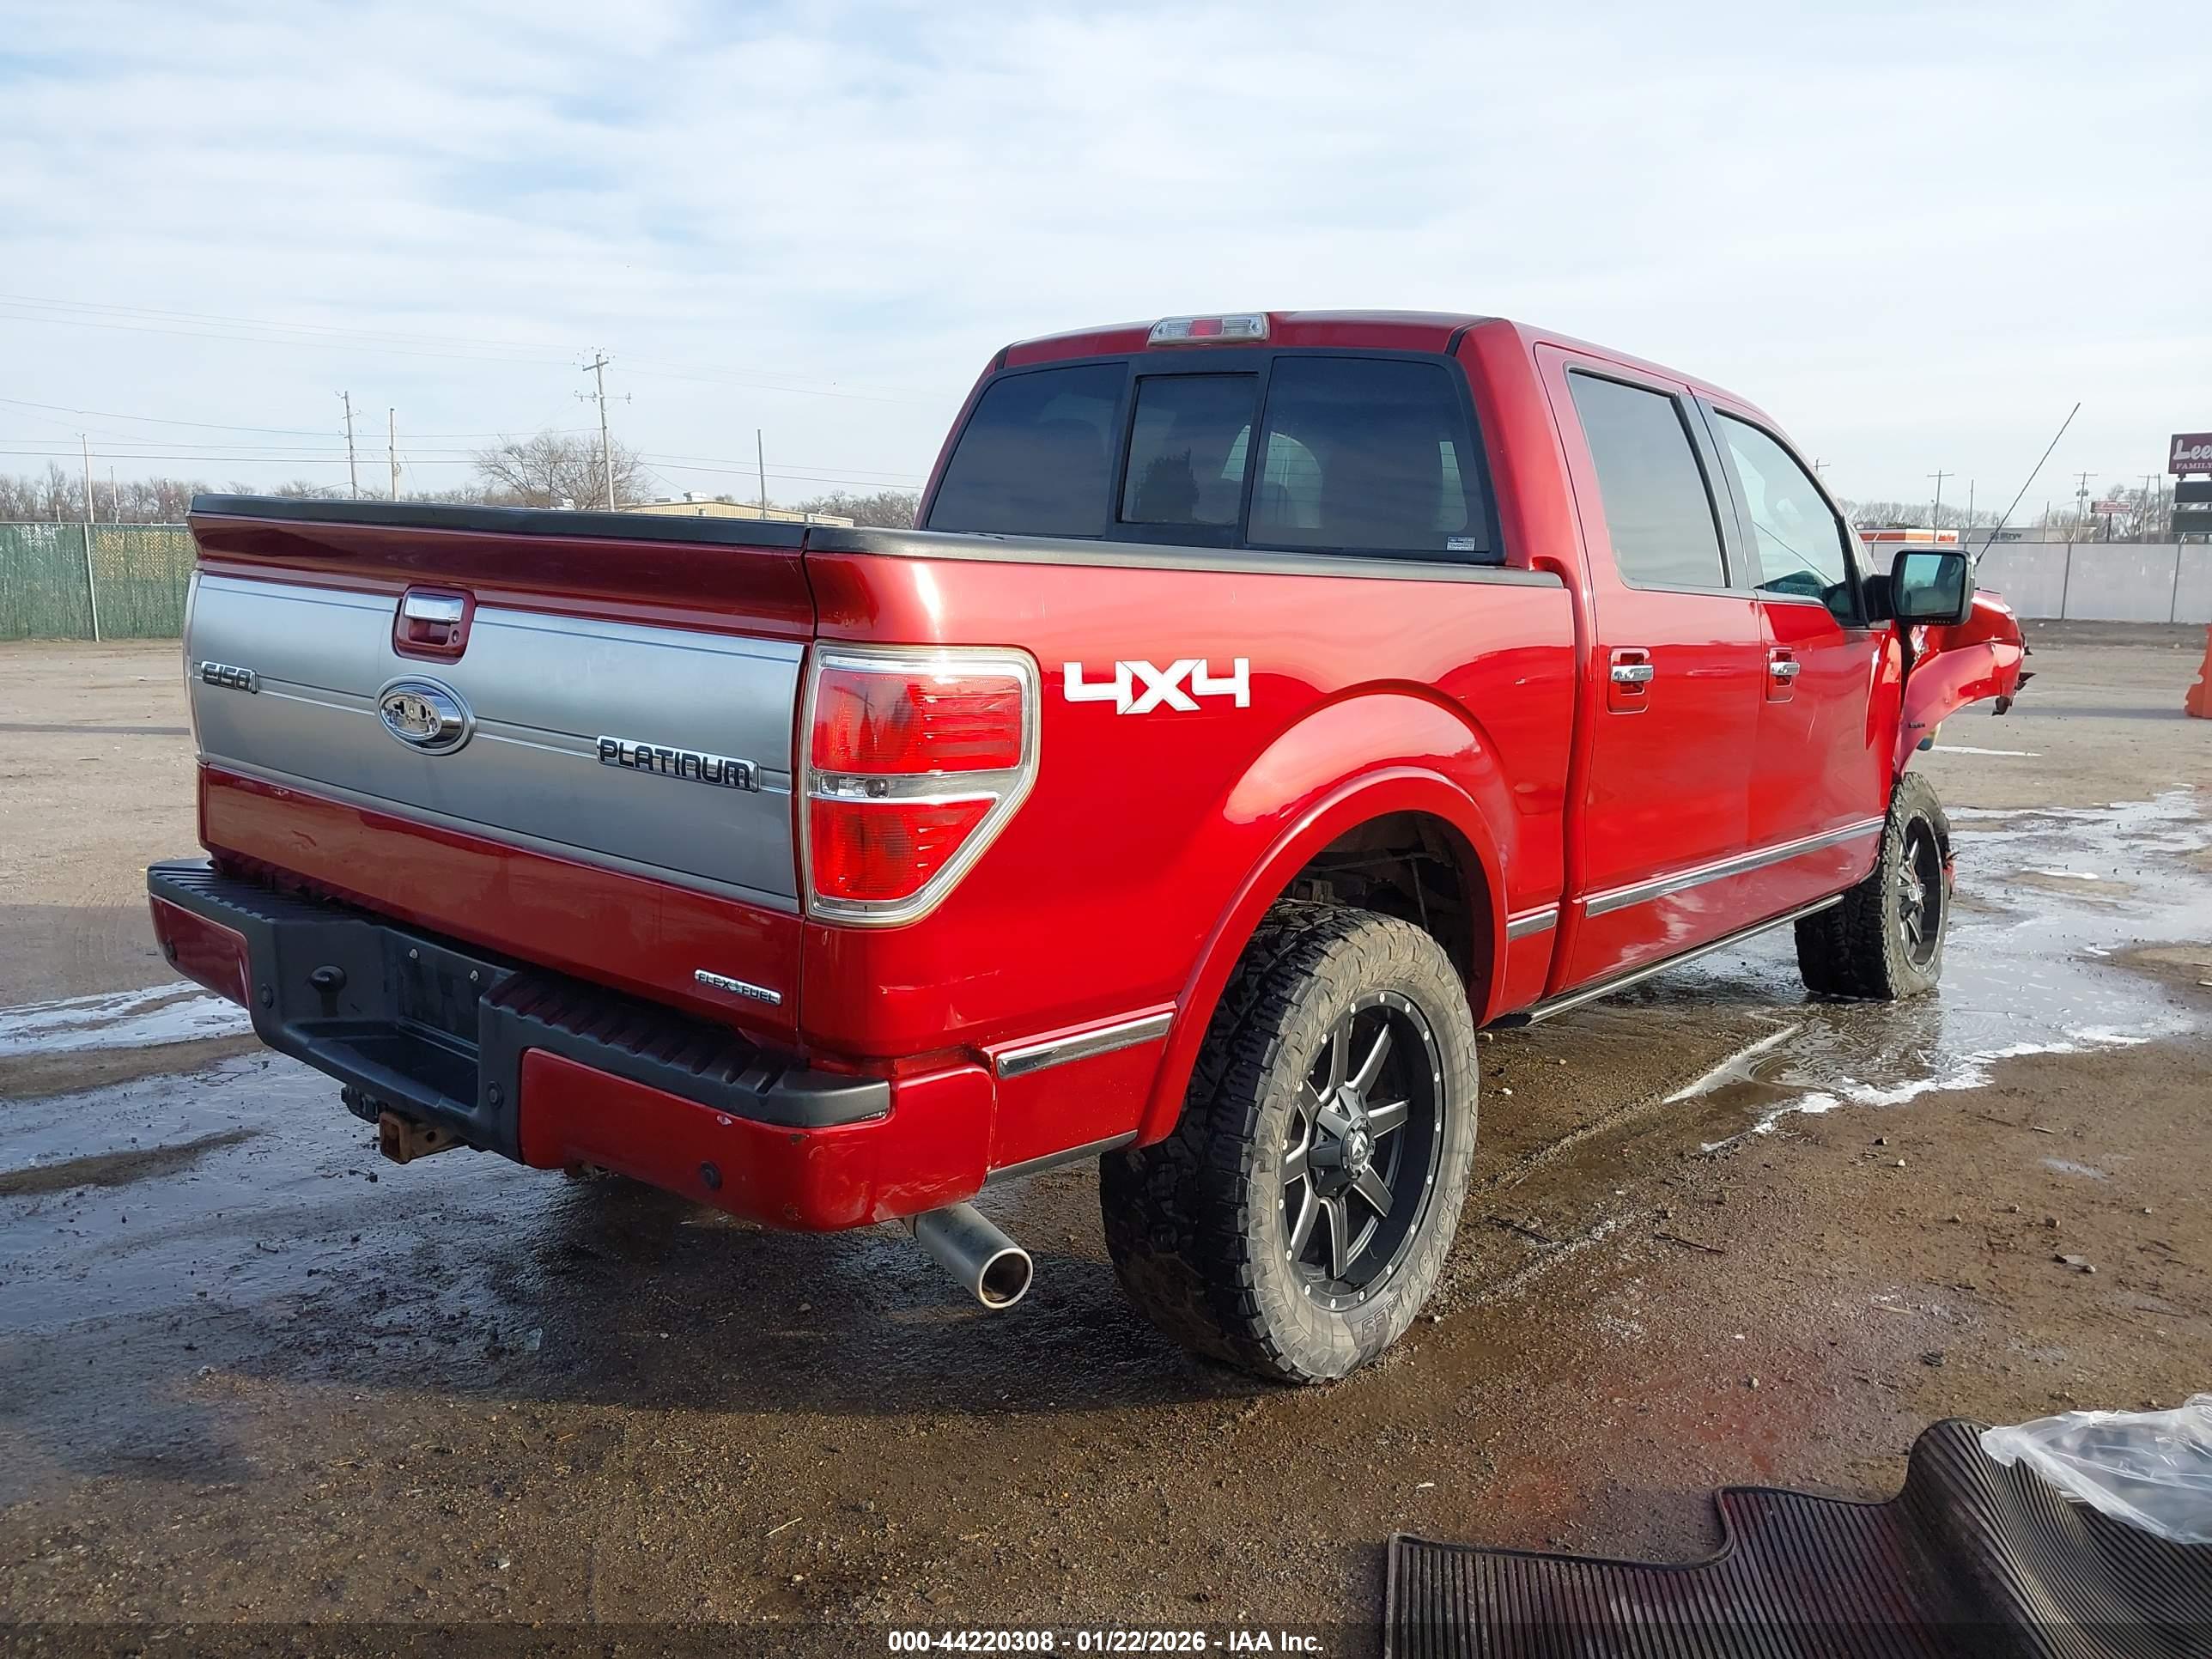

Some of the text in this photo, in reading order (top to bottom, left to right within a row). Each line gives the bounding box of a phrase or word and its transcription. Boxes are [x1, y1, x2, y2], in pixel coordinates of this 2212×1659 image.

[2172, 439, 2212, 460] Lee
[1063, 657, 1250, 714] 4X4
[600, 738, 750, 788] PLATINUM
[698, 973, 779, 1005] FLEX FUEL
